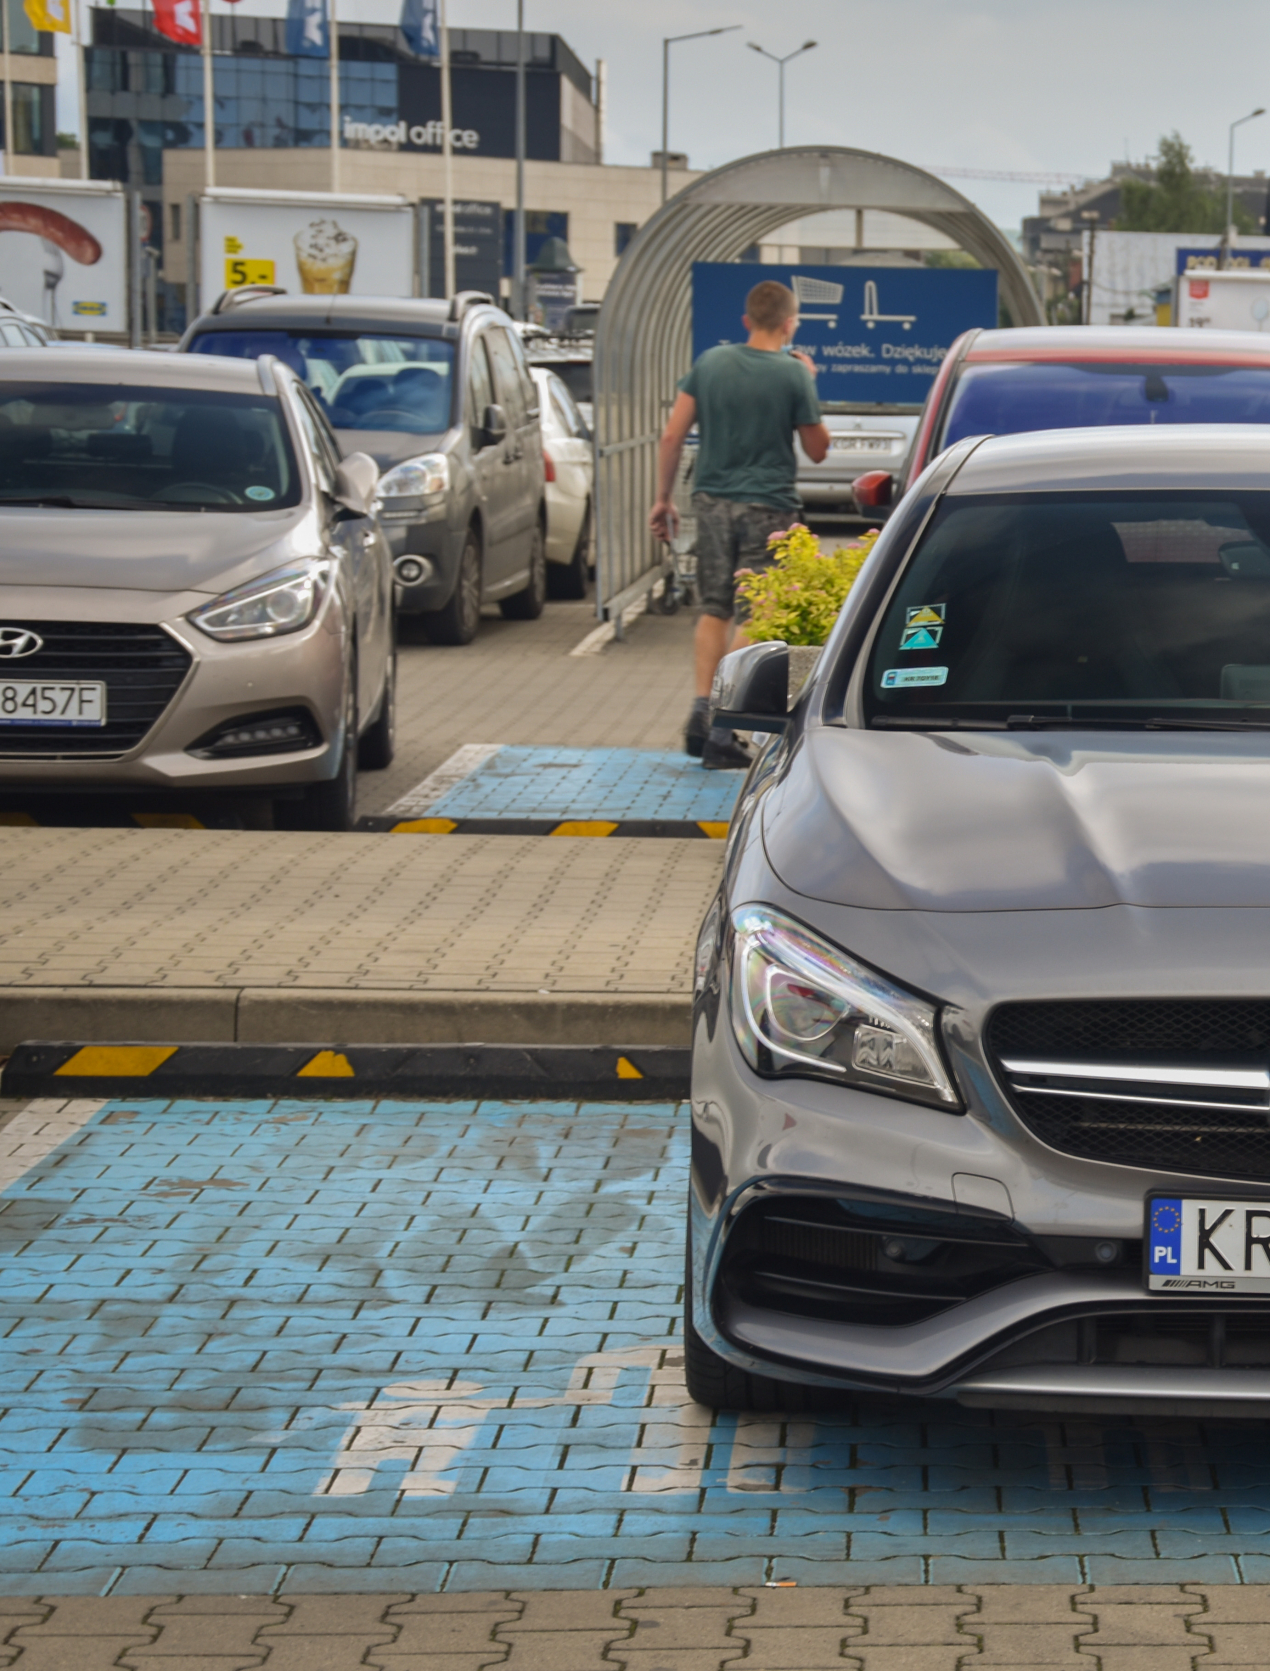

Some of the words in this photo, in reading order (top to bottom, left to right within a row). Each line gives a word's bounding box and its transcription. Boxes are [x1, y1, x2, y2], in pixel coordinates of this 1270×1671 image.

[409, 120, 479, 148] offce
[822, 342, 875, 358] wózek.
[2, 685, 97, 716] 8457F
[1153, 1246, 1178, 1265] PL
[1186, 1280, 1236, 1290] AMG
